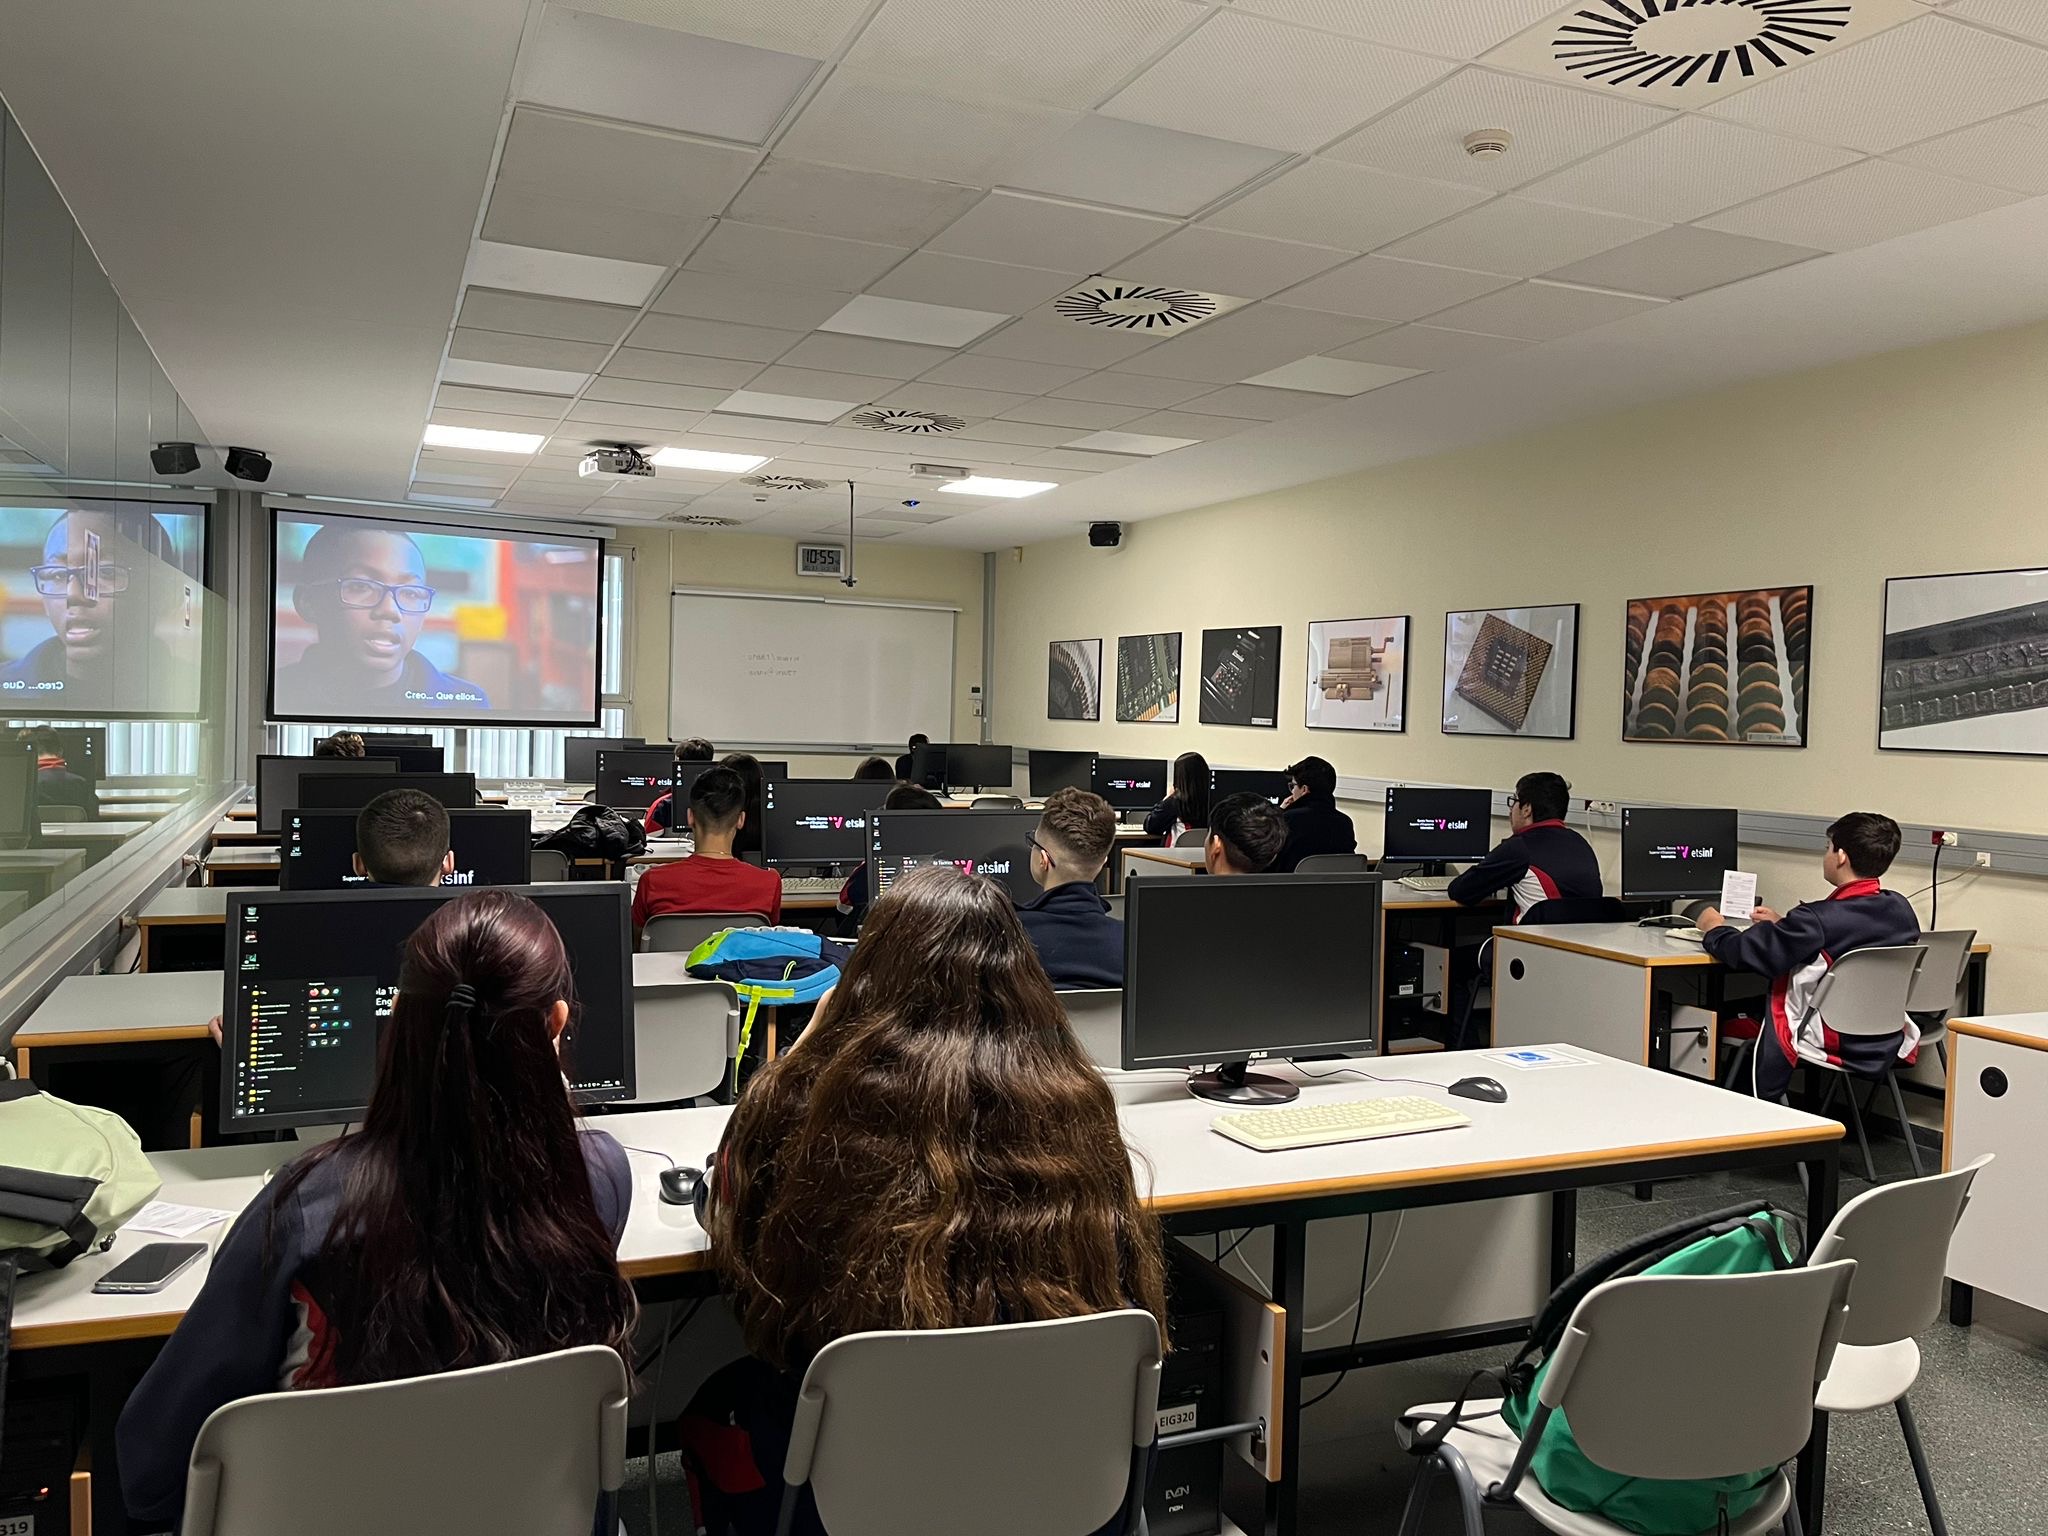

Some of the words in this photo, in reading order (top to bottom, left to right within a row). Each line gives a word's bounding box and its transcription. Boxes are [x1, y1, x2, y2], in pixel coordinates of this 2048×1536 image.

[806, 549, 835, 565] 10:55
[405, 690, 434, 700] Creo...
[435, 691, 454, 701] Que
[1691, 847, 1713, 858] etsinf
[977, 860, 1010, 874] etsinf
[387, 986, 400, 996] Tè
[1160, 1411, 1195, 1427] EIG320
